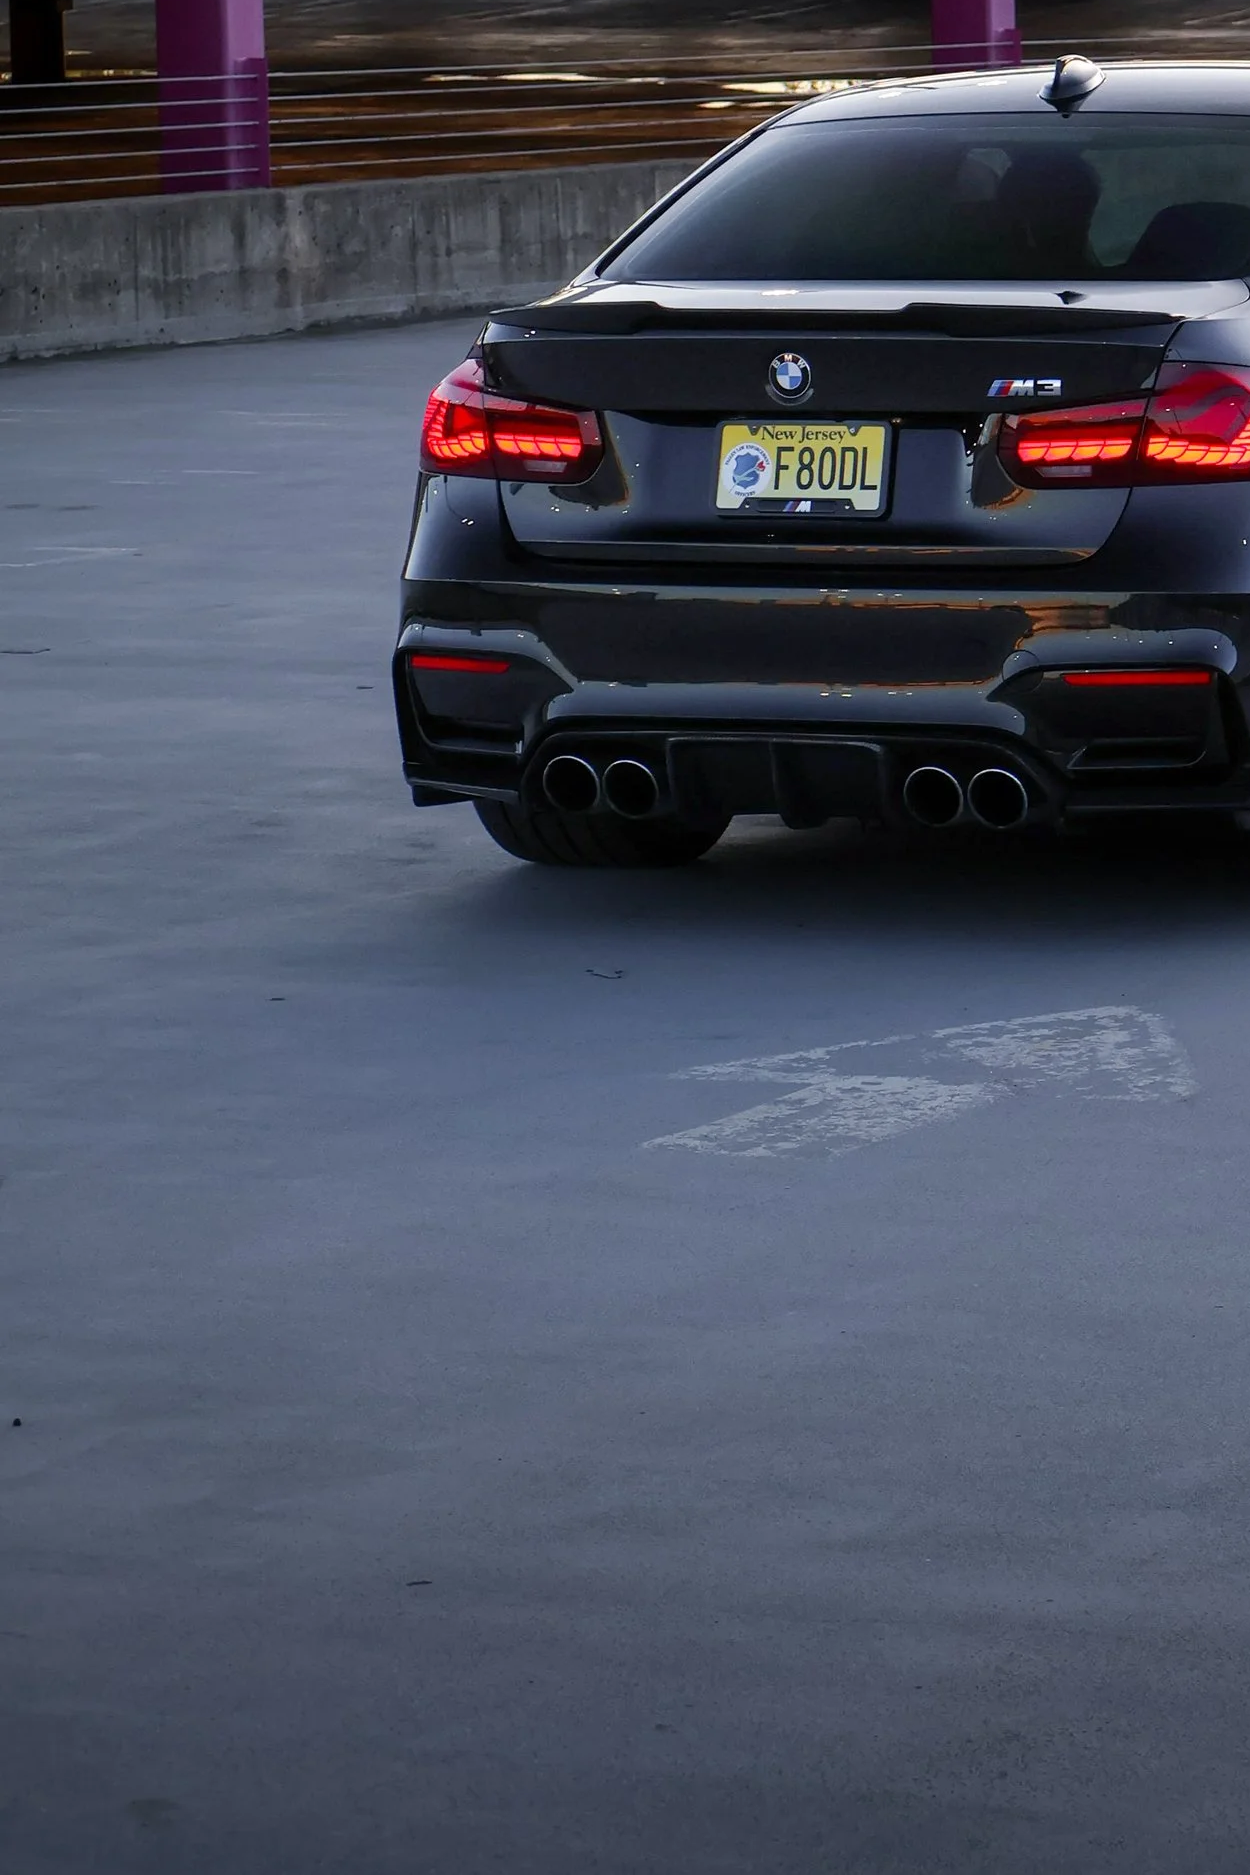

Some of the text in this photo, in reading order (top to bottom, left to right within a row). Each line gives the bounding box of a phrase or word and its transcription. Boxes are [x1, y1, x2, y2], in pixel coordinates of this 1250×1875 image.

[772, 354, 806, 369] BMW
[1008, 379, 1061, 397] M3
[761, 426, 846, 443] New Jersey
[774, 446, 877, 490] F80DL
[793, 500, 812, 513] M
